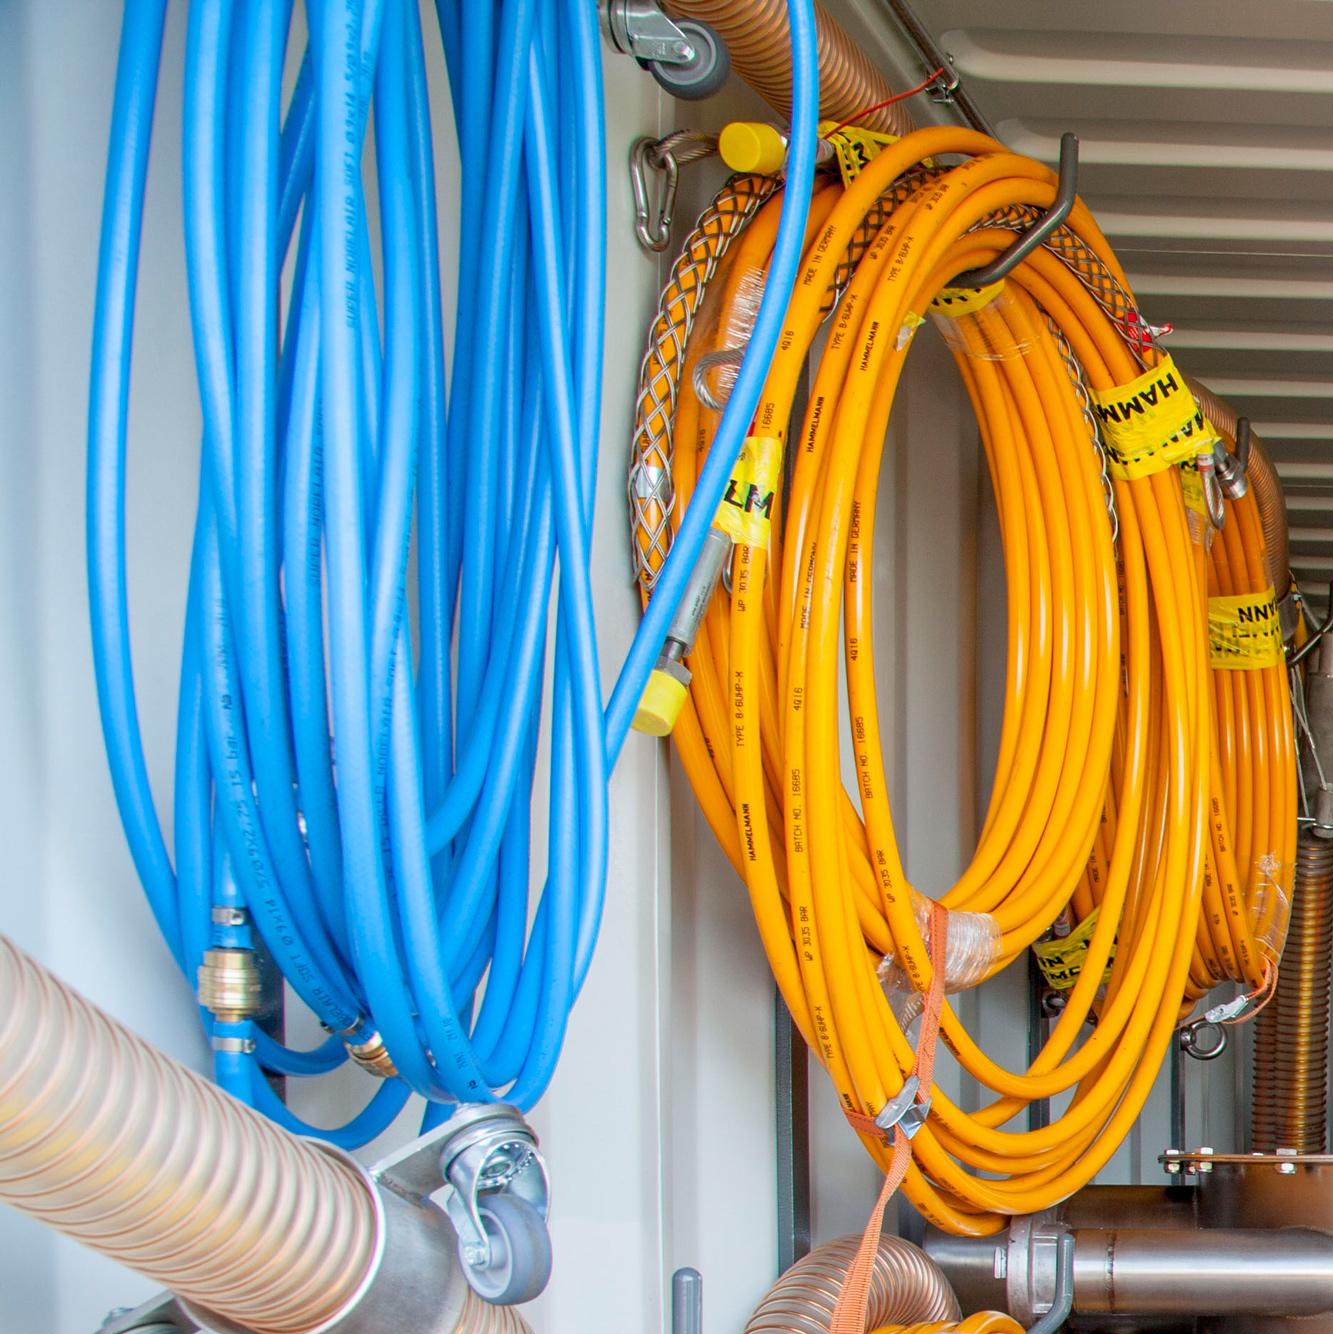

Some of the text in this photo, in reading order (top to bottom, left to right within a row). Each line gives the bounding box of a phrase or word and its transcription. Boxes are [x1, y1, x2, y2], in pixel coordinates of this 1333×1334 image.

[860, 321, 880, 371] HAMMELMANN
[807, 396, 824, 453] HAMMELMANN
[737, 724, 745, 747] TYPE
[742, 803, 756, 861] HAMMELMANN
[793, 823, 804, 853] BATCH
